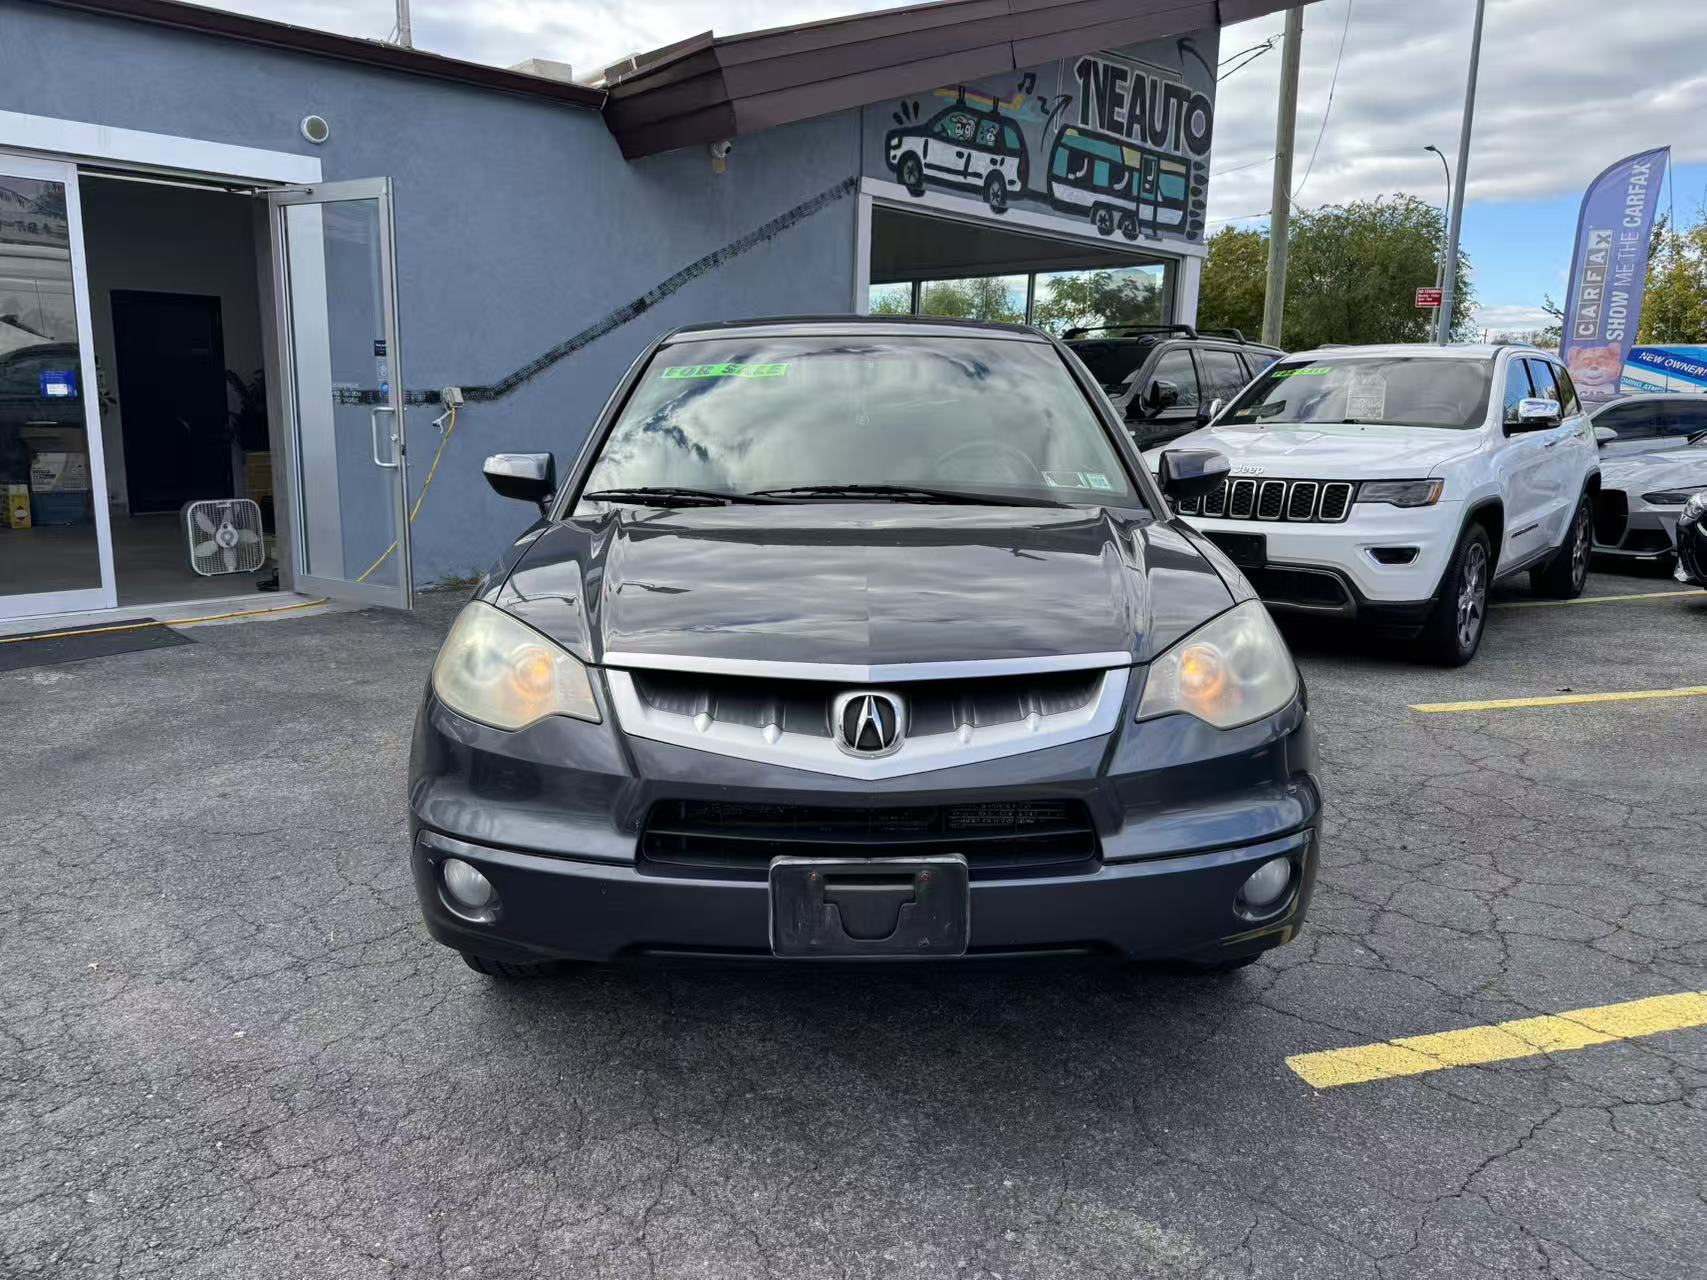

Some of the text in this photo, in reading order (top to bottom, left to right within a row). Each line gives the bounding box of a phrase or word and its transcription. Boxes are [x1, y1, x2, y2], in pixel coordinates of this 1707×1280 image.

[1606, 161, 1651, 340] SHOW ME THE CARFAX
[1578, 232, 1612, 337] CARFAX
[1639, 351, 1707, 376] NEW OWNER!
[1232, 463, 1265, 475] Jeep
